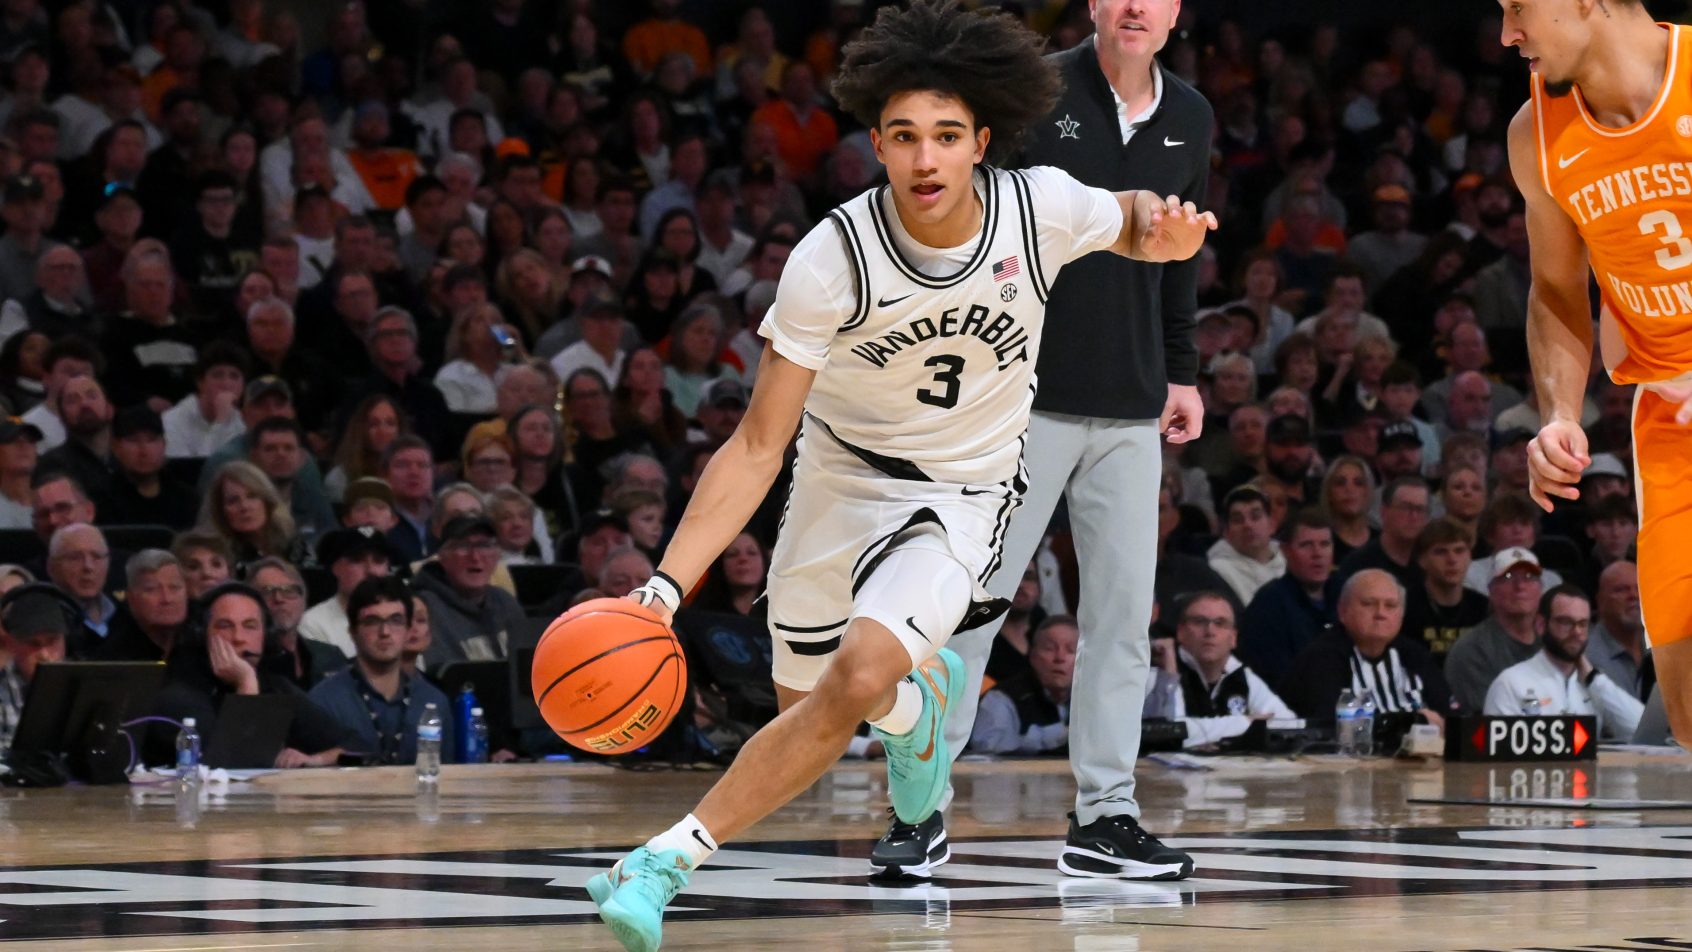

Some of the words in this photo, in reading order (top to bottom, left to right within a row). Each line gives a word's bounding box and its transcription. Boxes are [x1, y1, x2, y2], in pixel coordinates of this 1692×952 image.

[1568, 162, 1692, 225] TENNESS
[1638, 210, 1692, 271] 3
[1001, 284, 1017, 302] SEC
[851, 304, 1028, 371] VANDERBILT
[916, 354, 966, 409] 3
[587, 704, 662, 751] ELITE
[1489, 719, 1571, 756] POSS.
